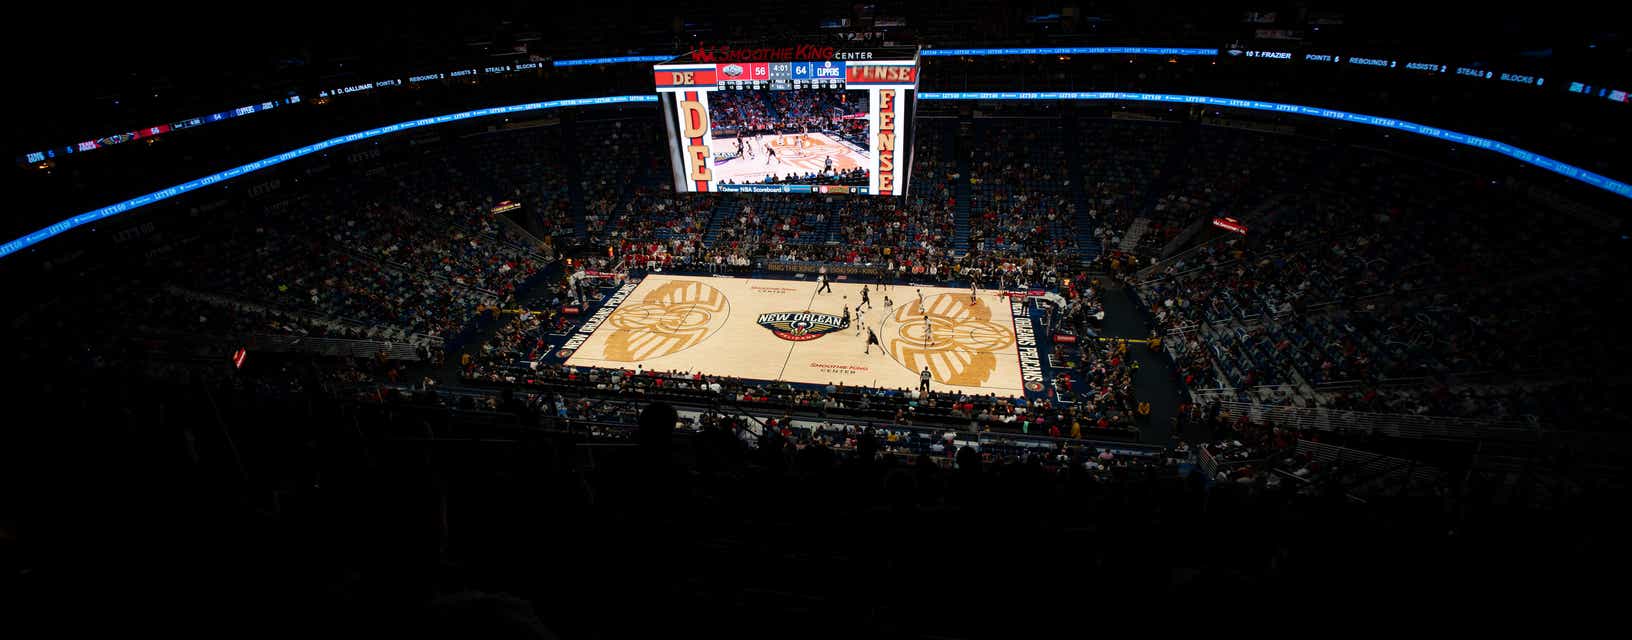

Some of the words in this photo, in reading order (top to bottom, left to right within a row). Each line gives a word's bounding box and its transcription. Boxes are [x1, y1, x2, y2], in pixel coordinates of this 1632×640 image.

[796, 44, 834, 60] KING
[834, 52, 873, 60] CENTER
[408, 74, 438, 82] REBOUNDS
[450, 70, 472, 78] ASSISTS
[755, 67, 766, 76] 56
[796, 66, 807, 75] 64
[817, 68, 840, 76] CLIPPERS
[1348, 57, 1388, 67] REBOUNDS
[1406, 62, 1438, 72] ASSISTS
[1456, 68, 1484, 78] STEALS
[1500, 73, 1534, 84] BLOCKS
[672, 72, 694, 86] DE
[680, 101, 712, 181] DE
[878, 89, 896, 191] FENSE
[758, 314, 790, 323] NEW
[794, 312, 844, 328] ORLEAN
[1014, 317, 1036, 346] ORLEANS
[1019, 346, 1044, 382] PELICANS
